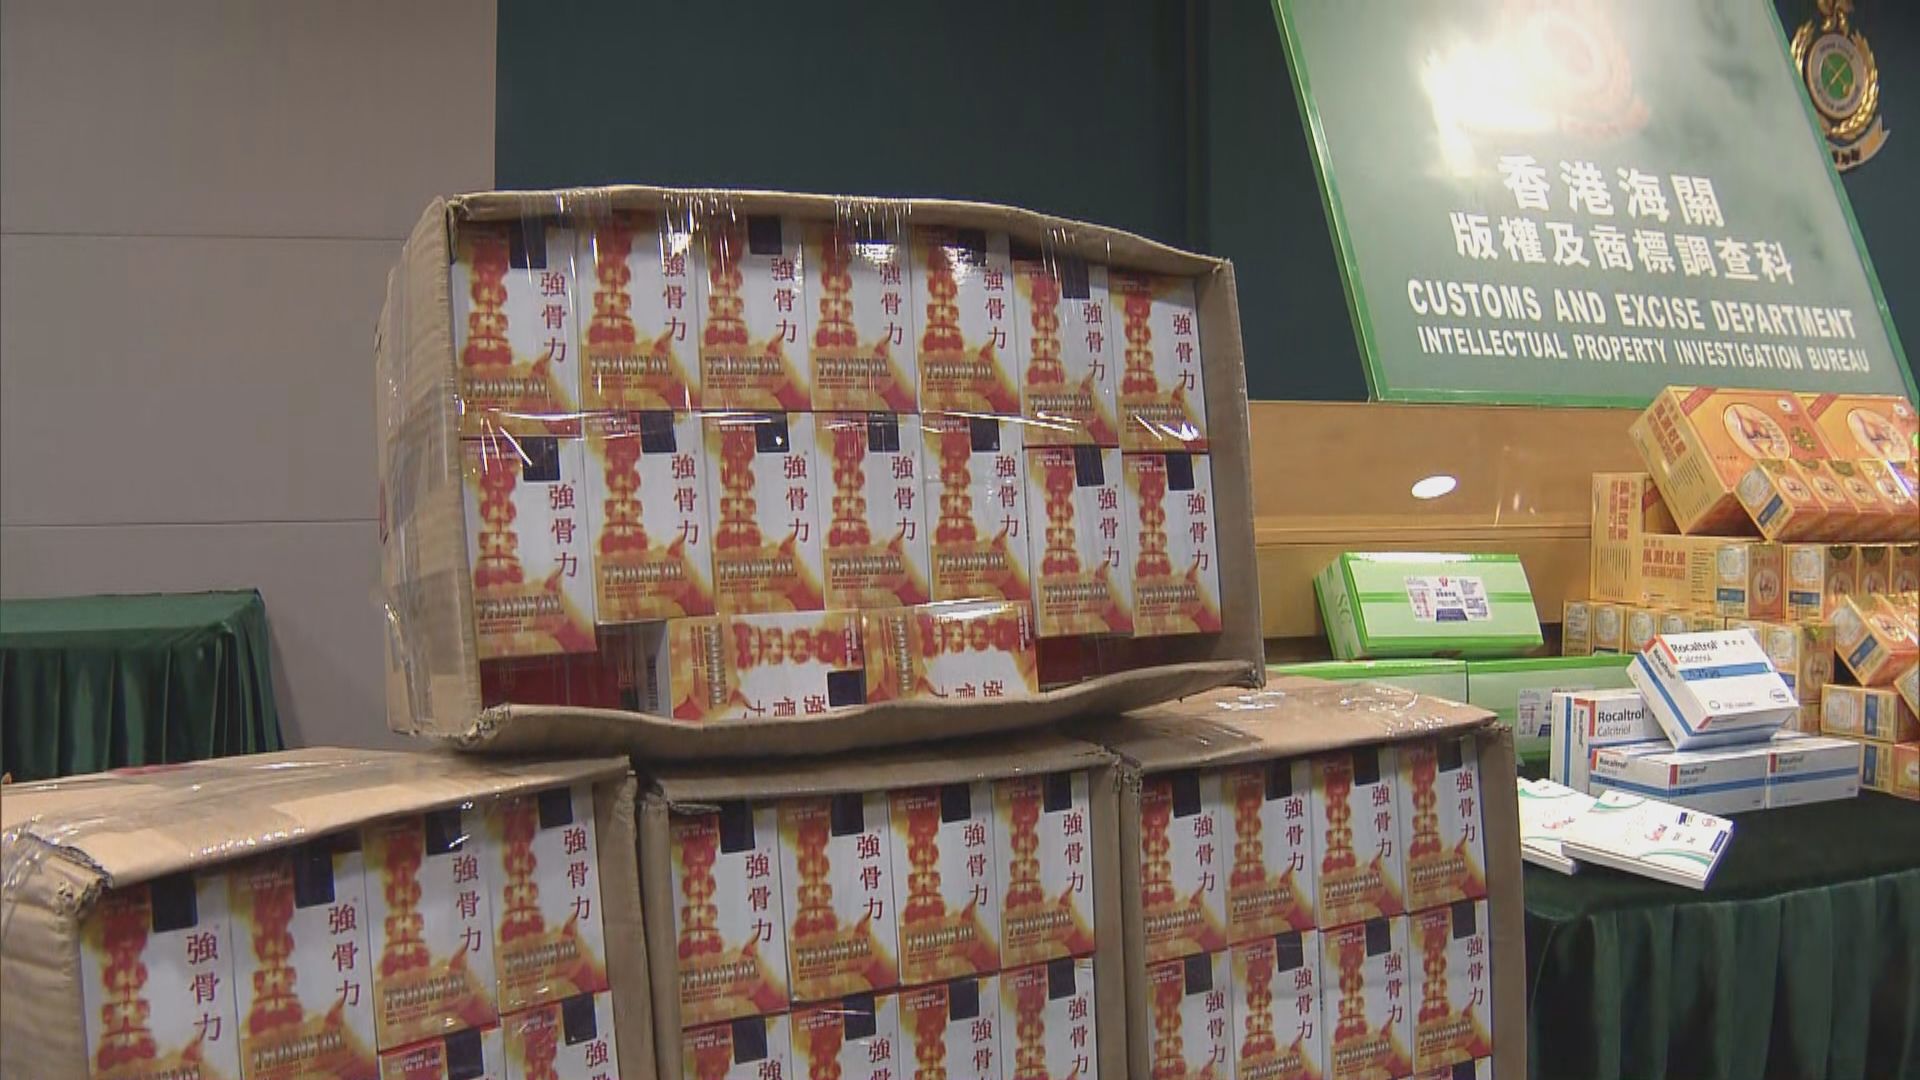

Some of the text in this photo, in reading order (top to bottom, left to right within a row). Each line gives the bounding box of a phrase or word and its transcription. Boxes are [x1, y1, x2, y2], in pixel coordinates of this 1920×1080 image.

[1498, 154, 1724, 227] 香港海關
[1448, 210, 1794, 285] 版權及商標調查科
[540, 270, 567, 363] 強骨力
[663, 254, 687, 341] 強骨力
[771, 256, 797, 343] 強骨力
[878, 262, 904, 345] 強骨力
[983, 269, 1007, 350] 強骨力
[1407, 279, 1857, 339] CUSTOMS AND EXCISE DEPARTMENT
[1082, 301, 1106, 382] 強骨力
[1172, 312, 1196, 392] 強骨力
[1417, 326, 1871, 374] INTELLECTUAL PROPERTY INVESTIGATION BUREAU
[549, 483, 577, 578] 強骨力
[671, 454, 698, 545] 強骨力
[784, 455, 810, 543] 強骨力
[891, 455, 916, 542] 強骨力
[995, 455, 1019, 539] 強骨力
[1098, 487, 1120, 567] 強骨力
[1186, 493, 1209, 571] 強骨力
[1598, 708, 1646, 723] Rocaltrol
[1284, 796, 1305, 872] 強骨力
[1371, 783, 1393, 858] 強骨力
[1455, 771, 1476, 843] 強骨力
[564, 827, 590, 919] 強骨力
[856, 833, 884, 921] 強骨力
[963, 823, 988, 906] 強骨力
[1063, 812, 1085, 893] 強骨力
[1193, 814, 1216, 892] 強骨力
[453, 855, 482, 952] 強骨力
[744, 852, 773, 943] 強骨力
[187, 931, 222, 1041] 強骨力
[327, 903, 360, 1007] 強骨力
[1383, 952, 1404, 1024] 強骨力
[1466, 936, 1485, 1007] 強骨力
[1067, 997, 1090, 1074] 強骨力
[1204, 990, 1227, 1065] 強骨力
[1293, 969, 1314, 1040] 強骨力
[970, 1018, 993, 1080] 強骨
